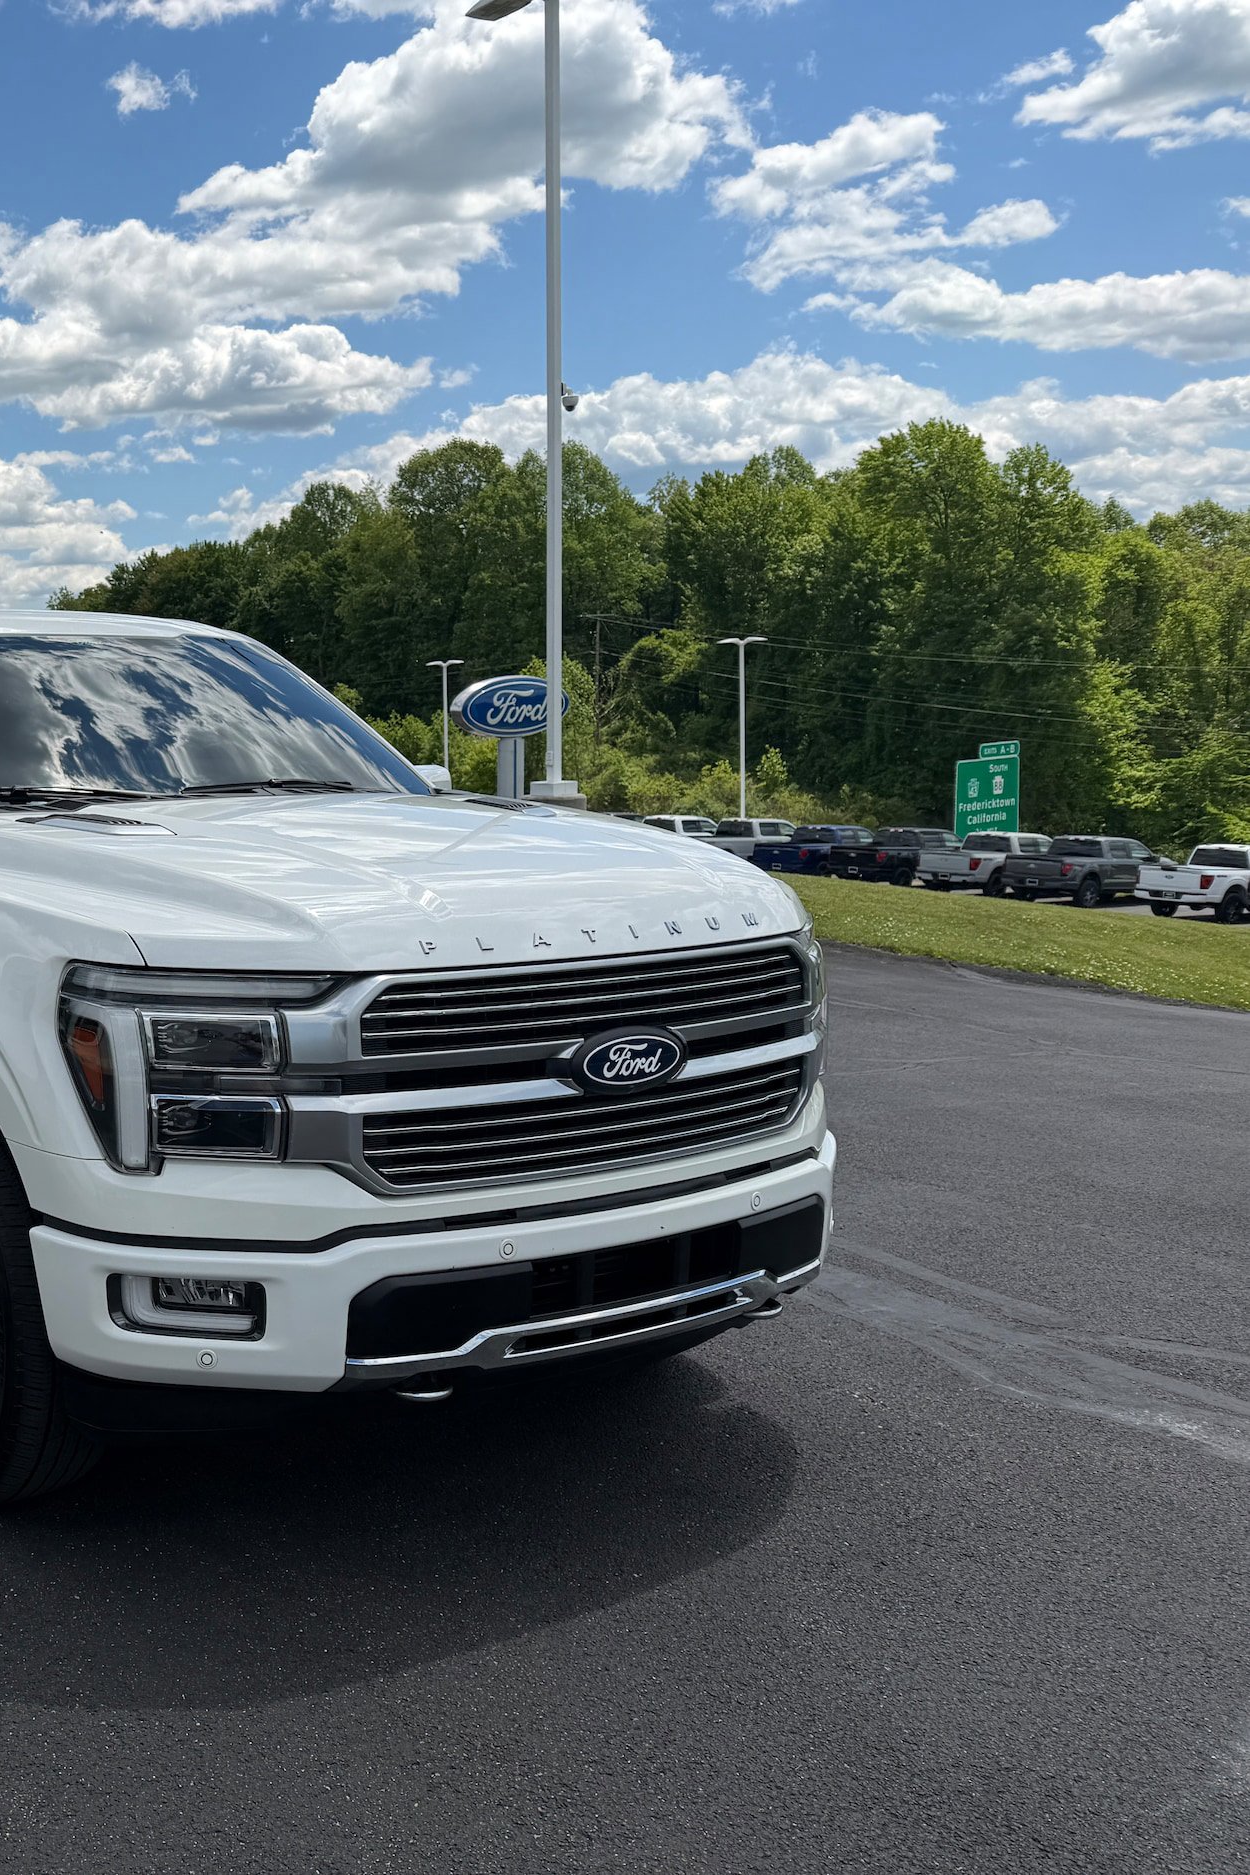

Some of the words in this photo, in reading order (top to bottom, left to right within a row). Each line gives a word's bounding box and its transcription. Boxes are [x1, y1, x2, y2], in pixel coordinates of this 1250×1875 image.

[486, 689, 548, 726] Ford
[989, 763, 1009, 773] SOUTH
[958, 797, 1016, 813] Fredericktown
[967, 811, 1007, 825] California
[418, 912, 760, 955] PLATINUM
[603, 1042, 663, 1079] Ford
